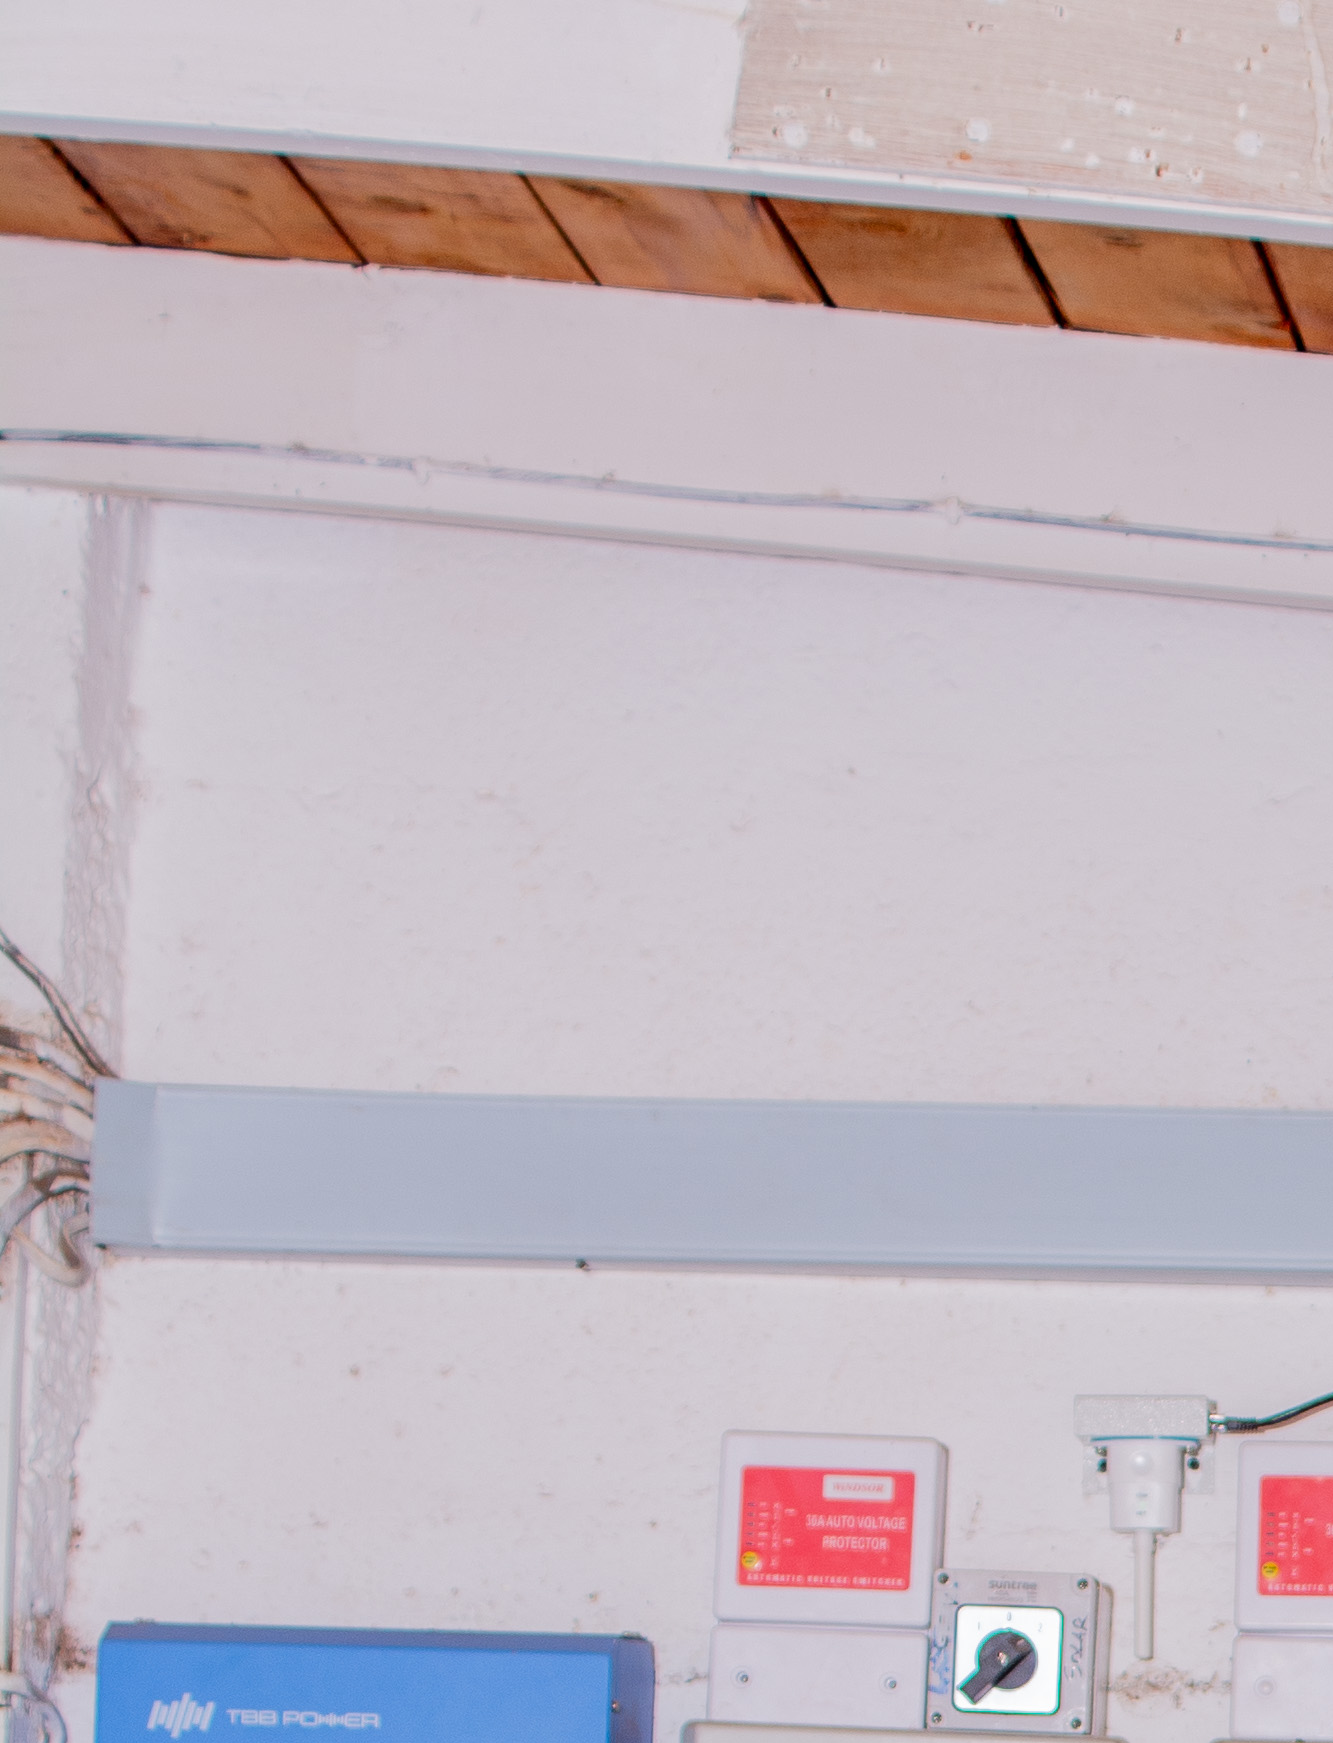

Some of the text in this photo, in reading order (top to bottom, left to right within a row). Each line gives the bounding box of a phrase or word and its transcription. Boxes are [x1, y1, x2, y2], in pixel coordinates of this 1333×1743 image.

[806, 1514, 907, 1530] 30A AUTO VOLTAGE
[822, 1535, 889, 1550] PROTECTOR
[226, 1709, 278, 1725] TBB
